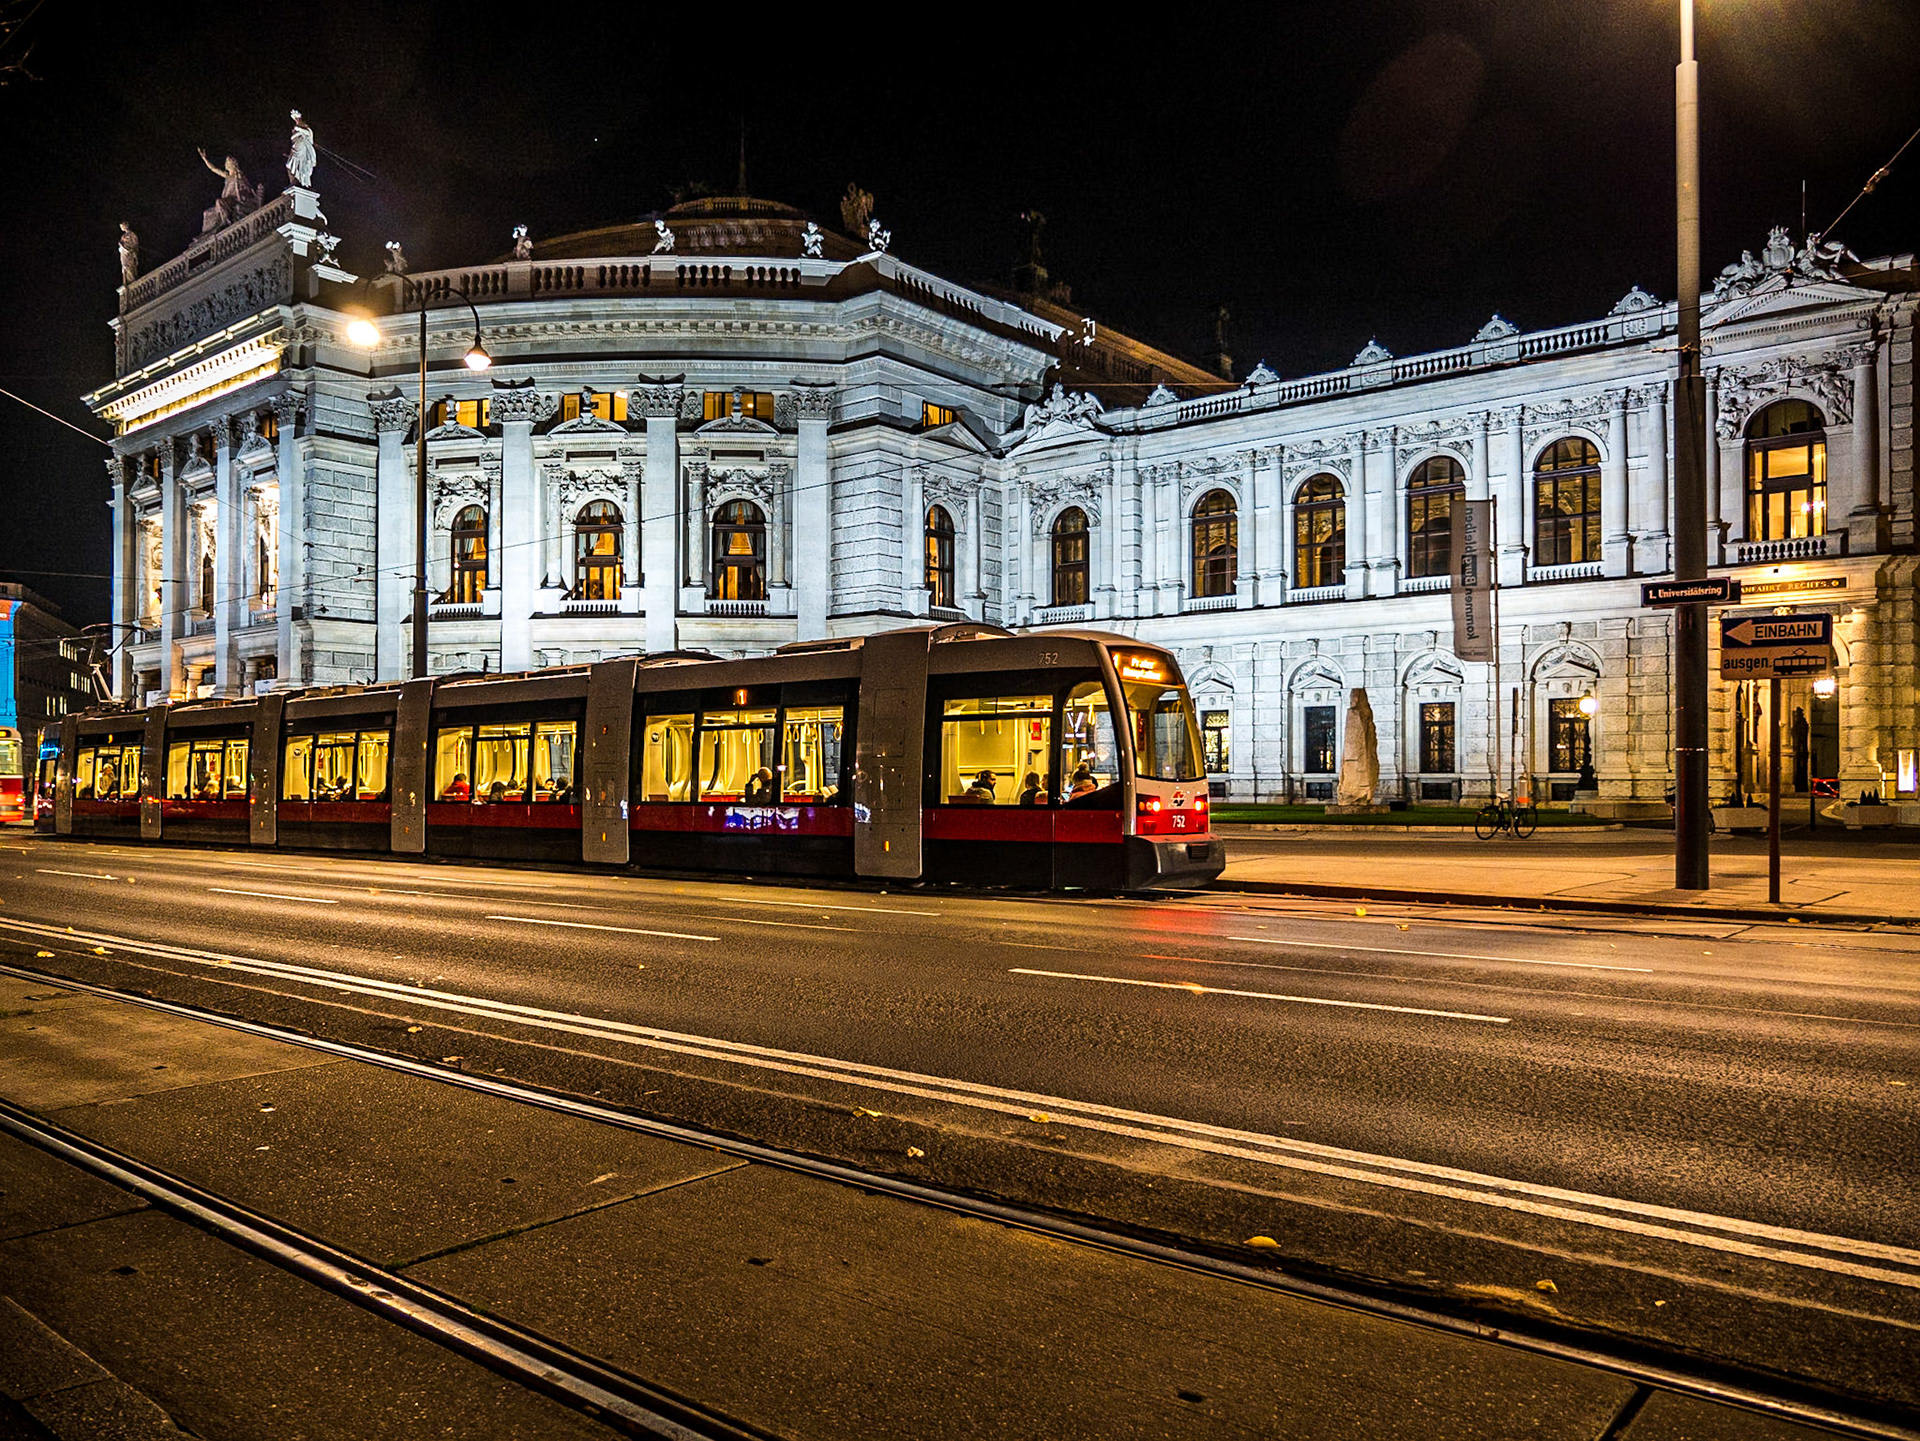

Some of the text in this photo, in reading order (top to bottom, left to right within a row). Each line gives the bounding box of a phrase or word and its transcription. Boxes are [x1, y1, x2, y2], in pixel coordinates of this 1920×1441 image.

[1658, 585, 1722, 598] Universitätsring
[1755, 623, 1817, 638] EINBAHN
[1039, 652, 1058, 665] 752
[1723, 657, 1772, 672] ausgen.
[1172, 815, 1185, 828] 752
